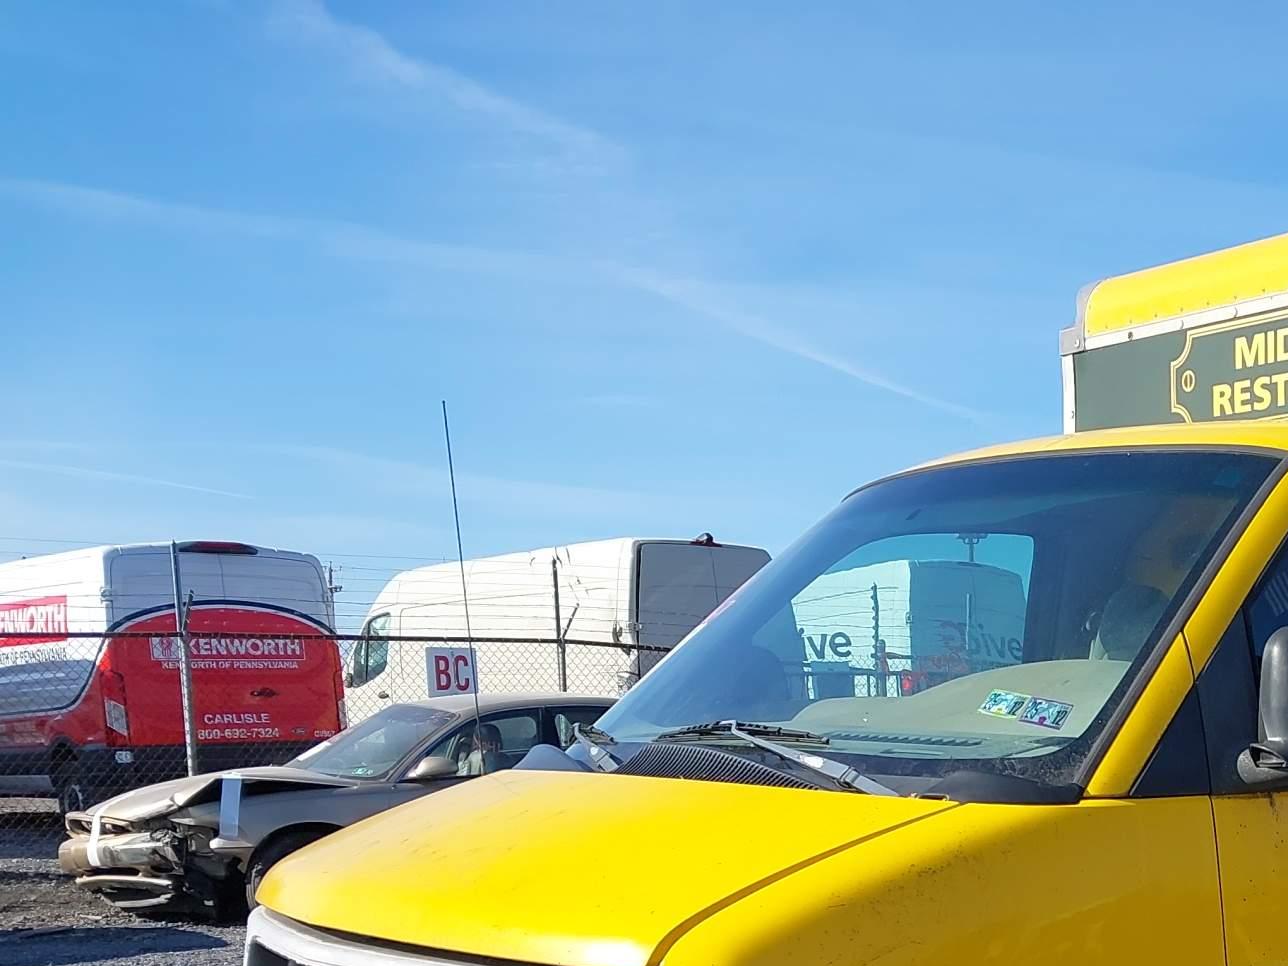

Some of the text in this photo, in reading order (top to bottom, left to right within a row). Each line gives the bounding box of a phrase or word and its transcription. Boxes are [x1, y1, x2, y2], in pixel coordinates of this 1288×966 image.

[189, 638, 301, 656] KENWORTH
[162, 661, 216, 669] KENORTH
[434, 655, 470, 691] BC
[204, 713, 270, 725] CARLISLE
